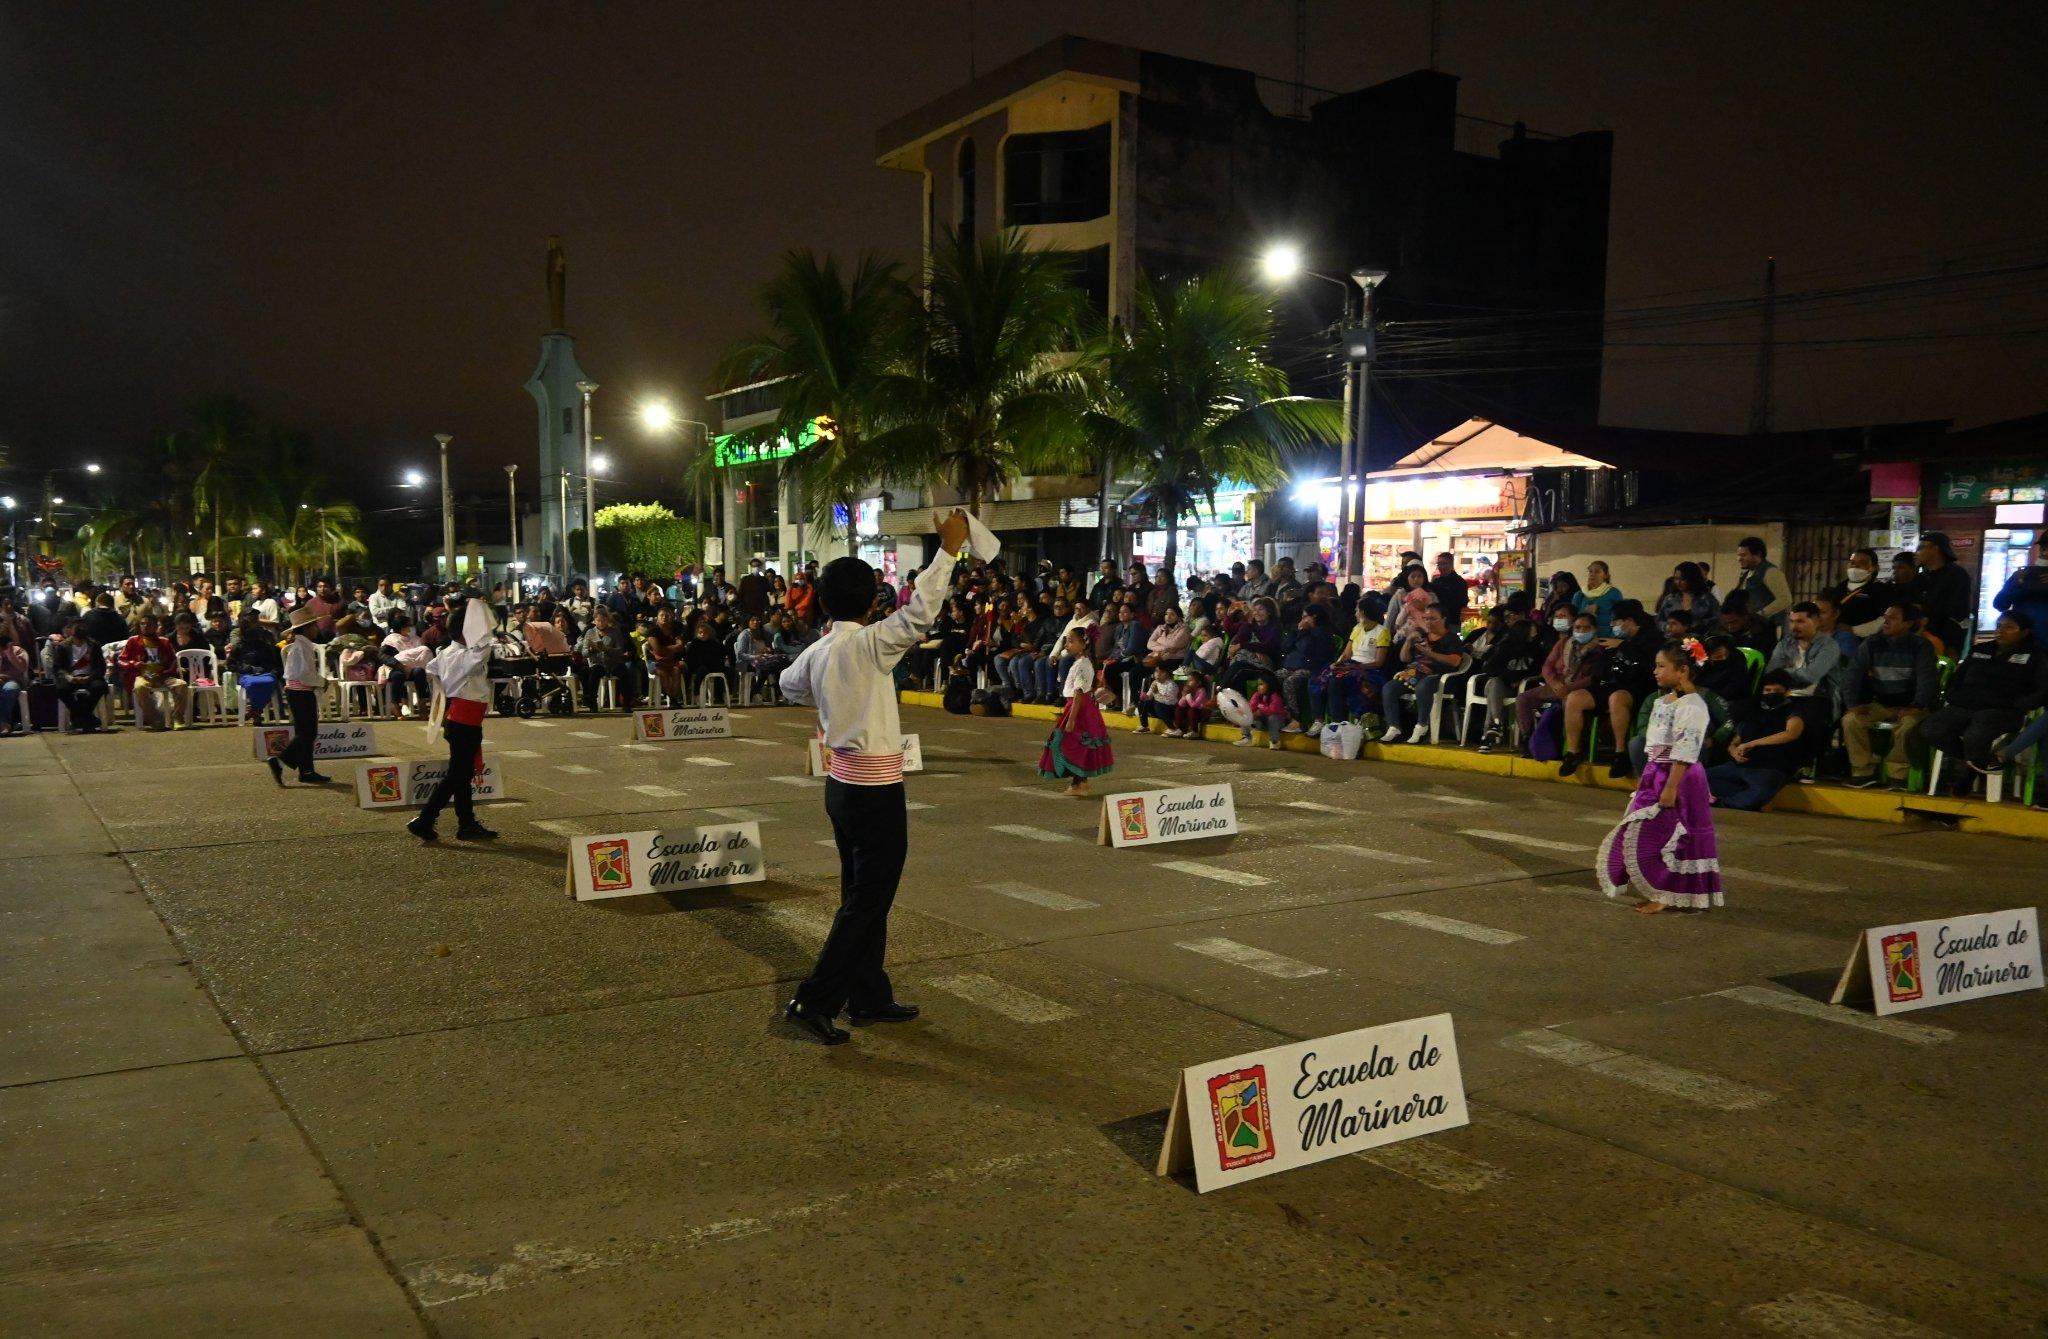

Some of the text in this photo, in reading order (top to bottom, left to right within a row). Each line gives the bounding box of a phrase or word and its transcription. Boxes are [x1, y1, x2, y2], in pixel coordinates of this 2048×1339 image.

[352, 727, 366, 738] de
[671, 712, 724, 724] Escuela de
[1156, 792, 1225, 815] Escuela de
[1158, 815, 1229, 837] Marinera
[647, 831, 750, 860] Escuela de
[649, 860, 752, 887] Marinera
[1934, 919, 2029, 959] Escuela de
[1936, 960, 2032, 996] Marinera
[1293, 1034, 1442, 1099] Escuela de
[1212, 1102, 1224, 1142] BALLET
[1259, 1087, 1272, 1131] DANZAS
[1297, 1093, 1449, 1152] Marinera
